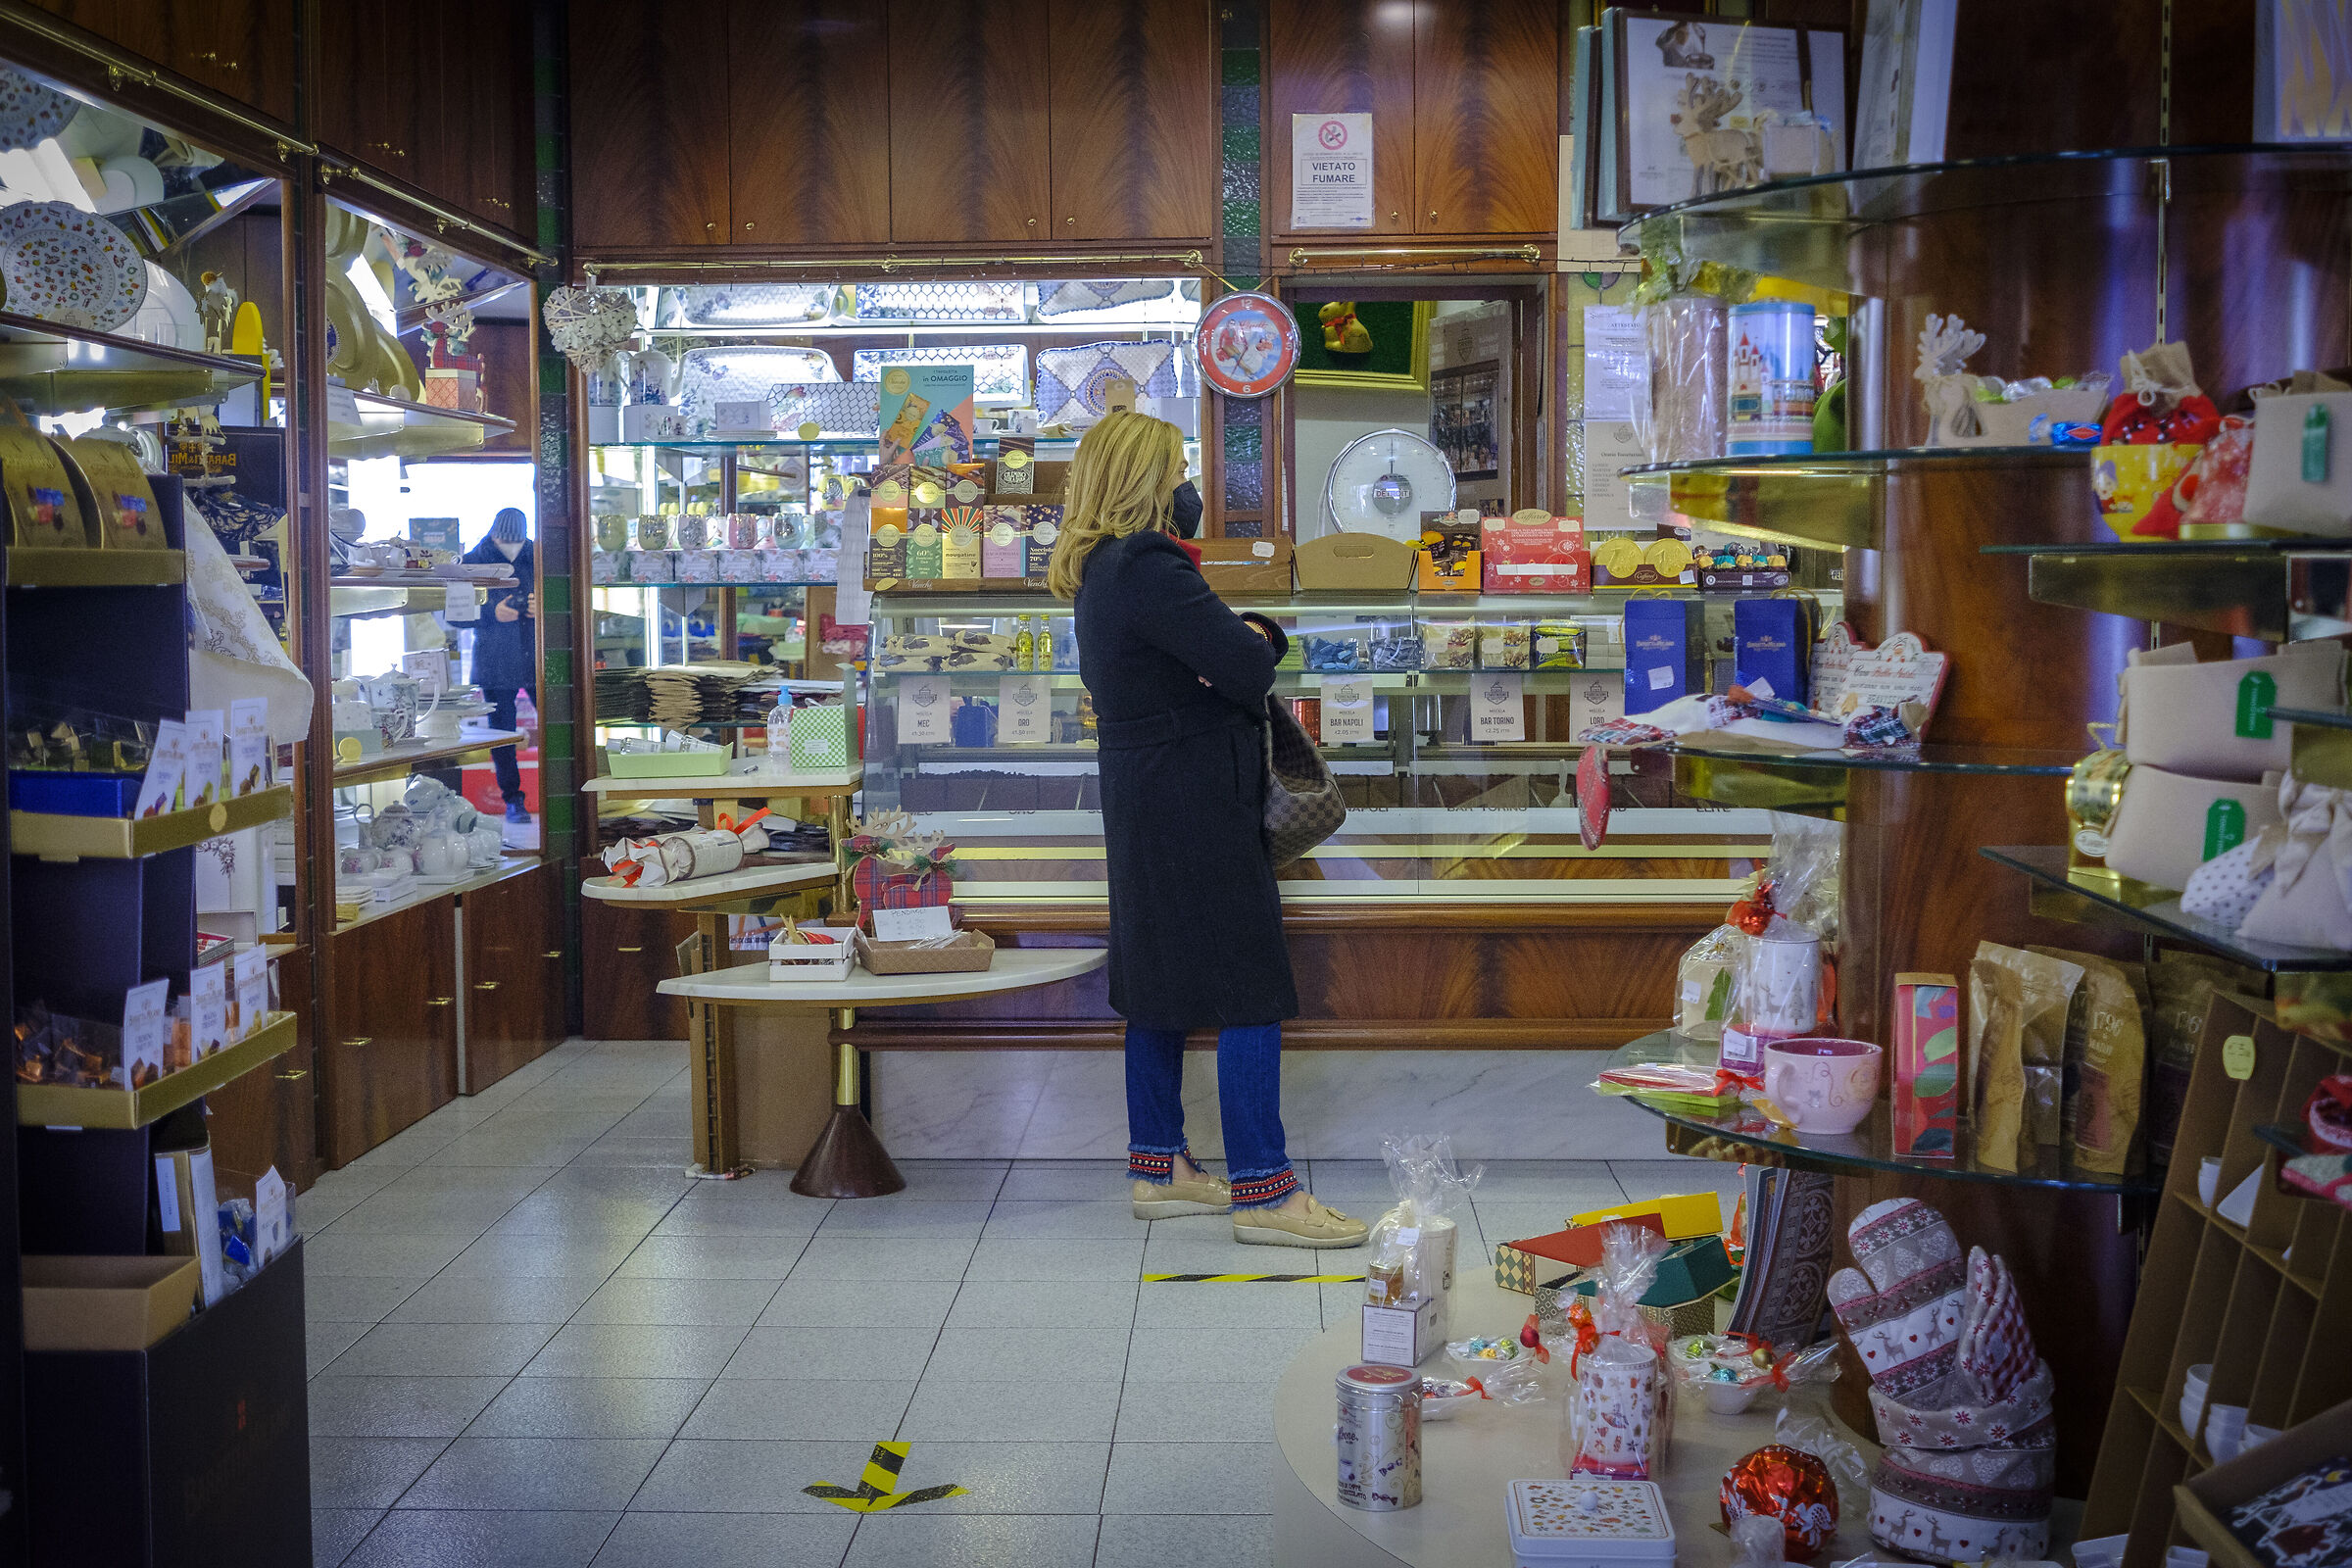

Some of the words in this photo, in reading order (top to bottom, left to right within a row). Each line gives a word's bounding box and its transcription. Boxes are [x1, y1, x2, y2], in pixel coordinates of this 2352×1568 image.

[1312, 162, 1356, 172] VIETATO
[1312, 173, 1356, 183] FUMARE
[1240, 298, 1253, 309] 12
[1242, 384, 1251, 394] 6
[1330, 718, 1342, 727] BAR
[1343, 718, 1364, 727] NAPOLI
[1480, 716, 1493, 725] BAR
[1494, 716, 1514, 725] TORINO
[1590, 716, 1605, 725] LORD
